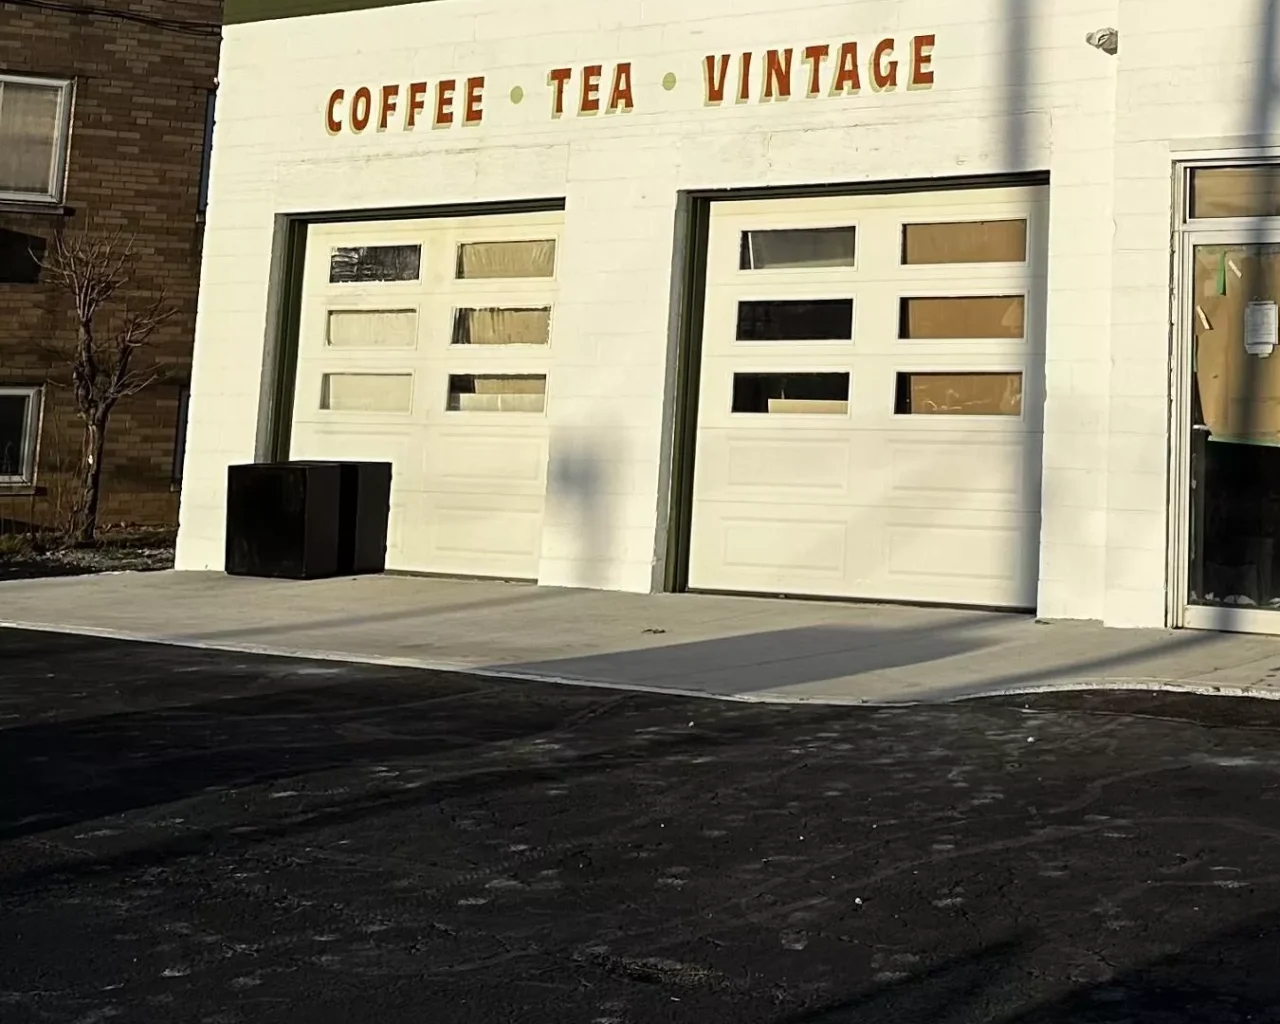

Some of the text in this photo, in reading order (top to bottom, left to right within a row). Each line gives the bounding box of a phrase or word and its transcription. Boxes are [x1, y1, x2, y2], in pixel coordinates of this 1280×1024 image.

[325, 34, 936, 135] COFFEE TEA VINTAGE
